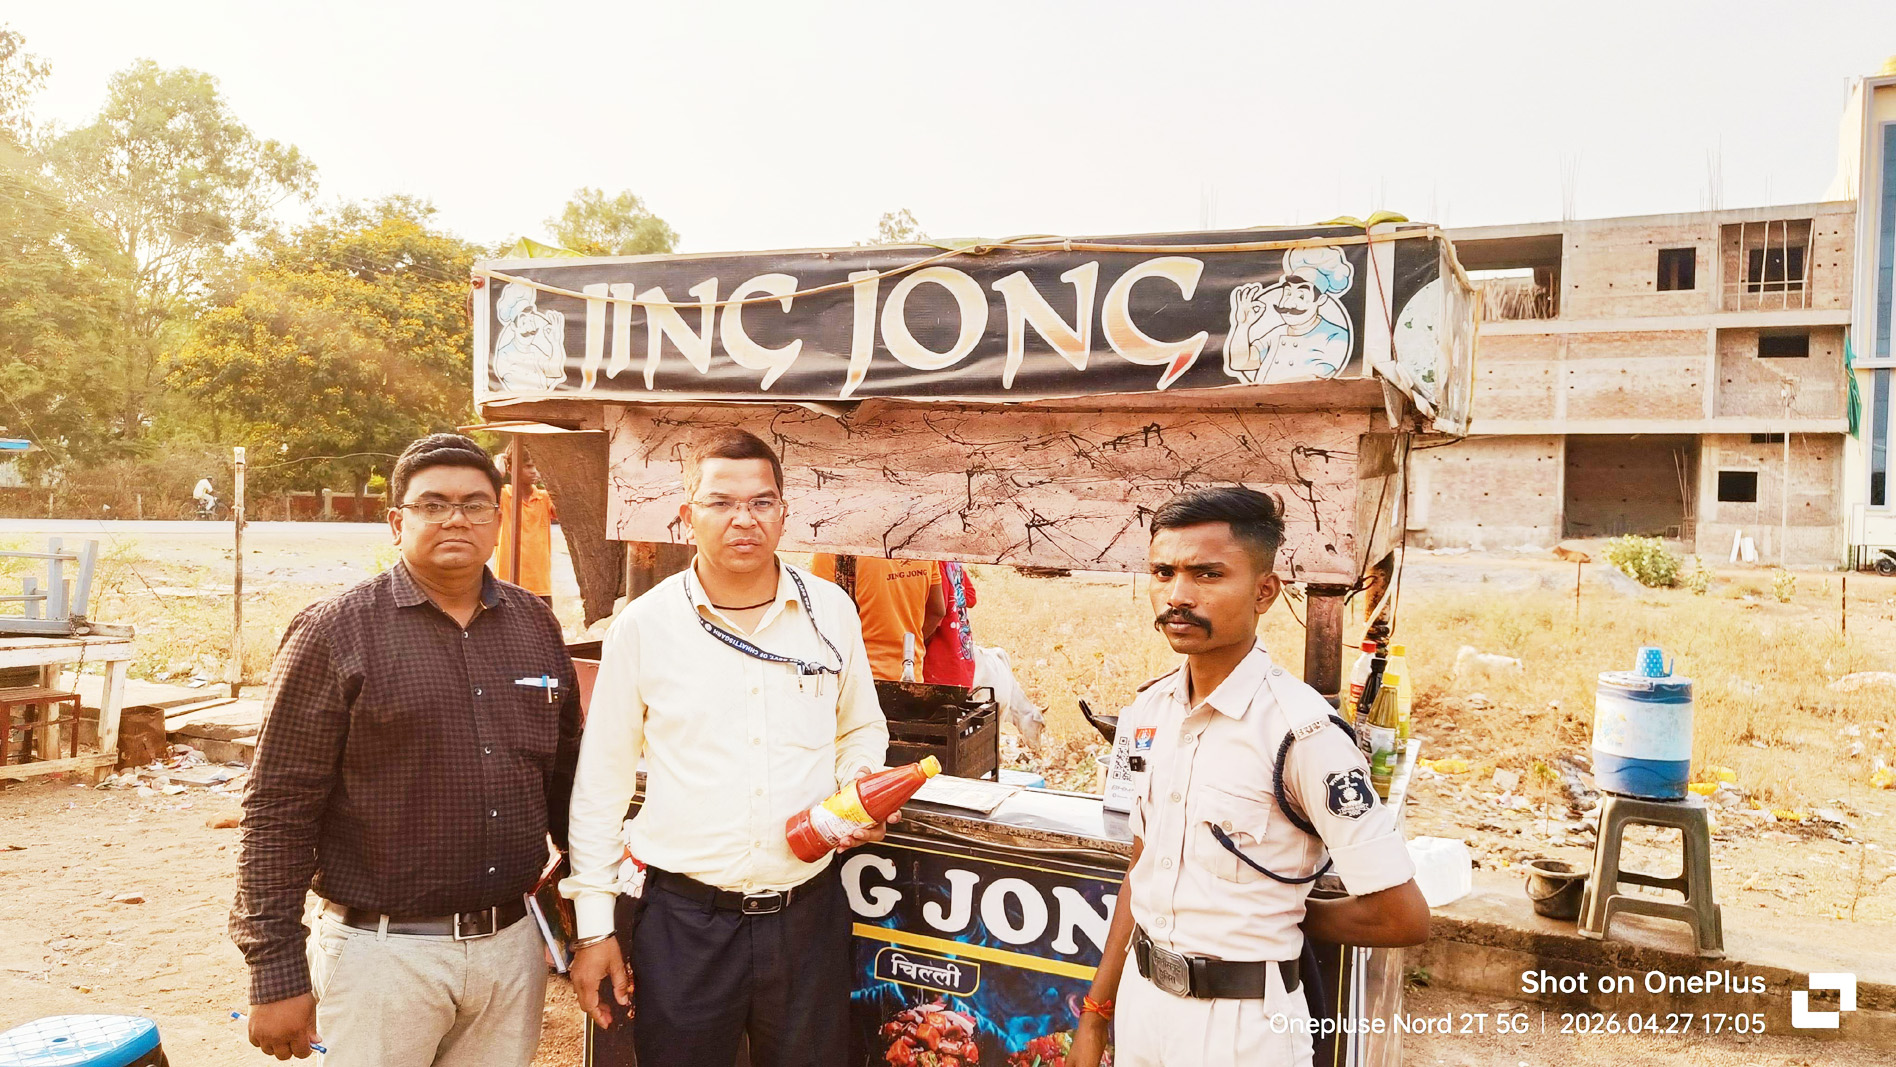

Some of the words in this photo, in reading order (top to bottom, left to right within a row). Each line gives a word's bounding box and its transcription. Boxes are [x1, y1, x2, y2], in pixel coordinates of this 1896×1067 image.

[582, 273, 803, 392] JING
[839, 256, 1209, 399] JONG
[906, 569, 928, 578] JONG
[713, 628, 759, 656] CHHATTISGARH
[922, 868, 1117, 955] JON
[891, 953, 961, 988] चिल्ली
